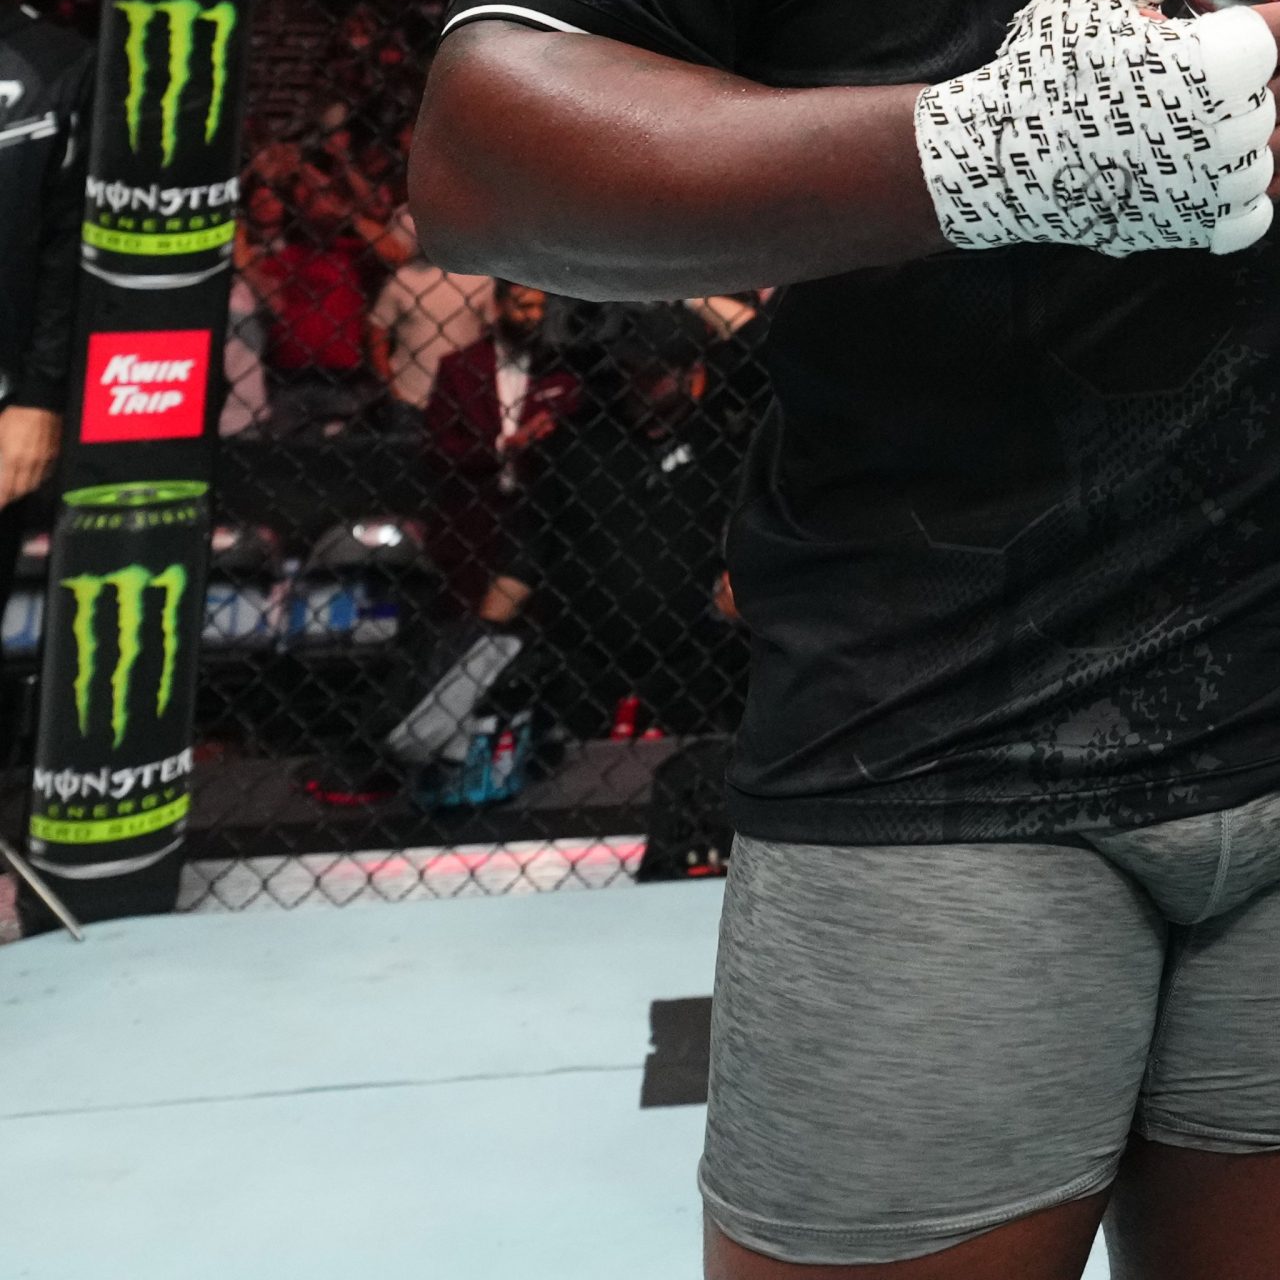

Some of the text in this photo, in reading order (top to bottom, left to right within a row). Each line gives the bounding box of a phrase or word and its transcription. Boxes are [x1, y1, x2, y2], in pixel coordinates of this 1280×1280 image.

[1074, 94, 1100, 138] UFC
[1110, 91, 1135, 136] UFC
[1162, 95, 1194, 140] UFC
[950, 145, 988, 189] UFC
[1010, 153, 1044, 195] UFC
[1147, 132, 1178, 175] UFC
[86, 176, 240, 217] MONSTER
[941, 181, 982, 223] UFC
[33, 746, 193, 804] MONSTER
